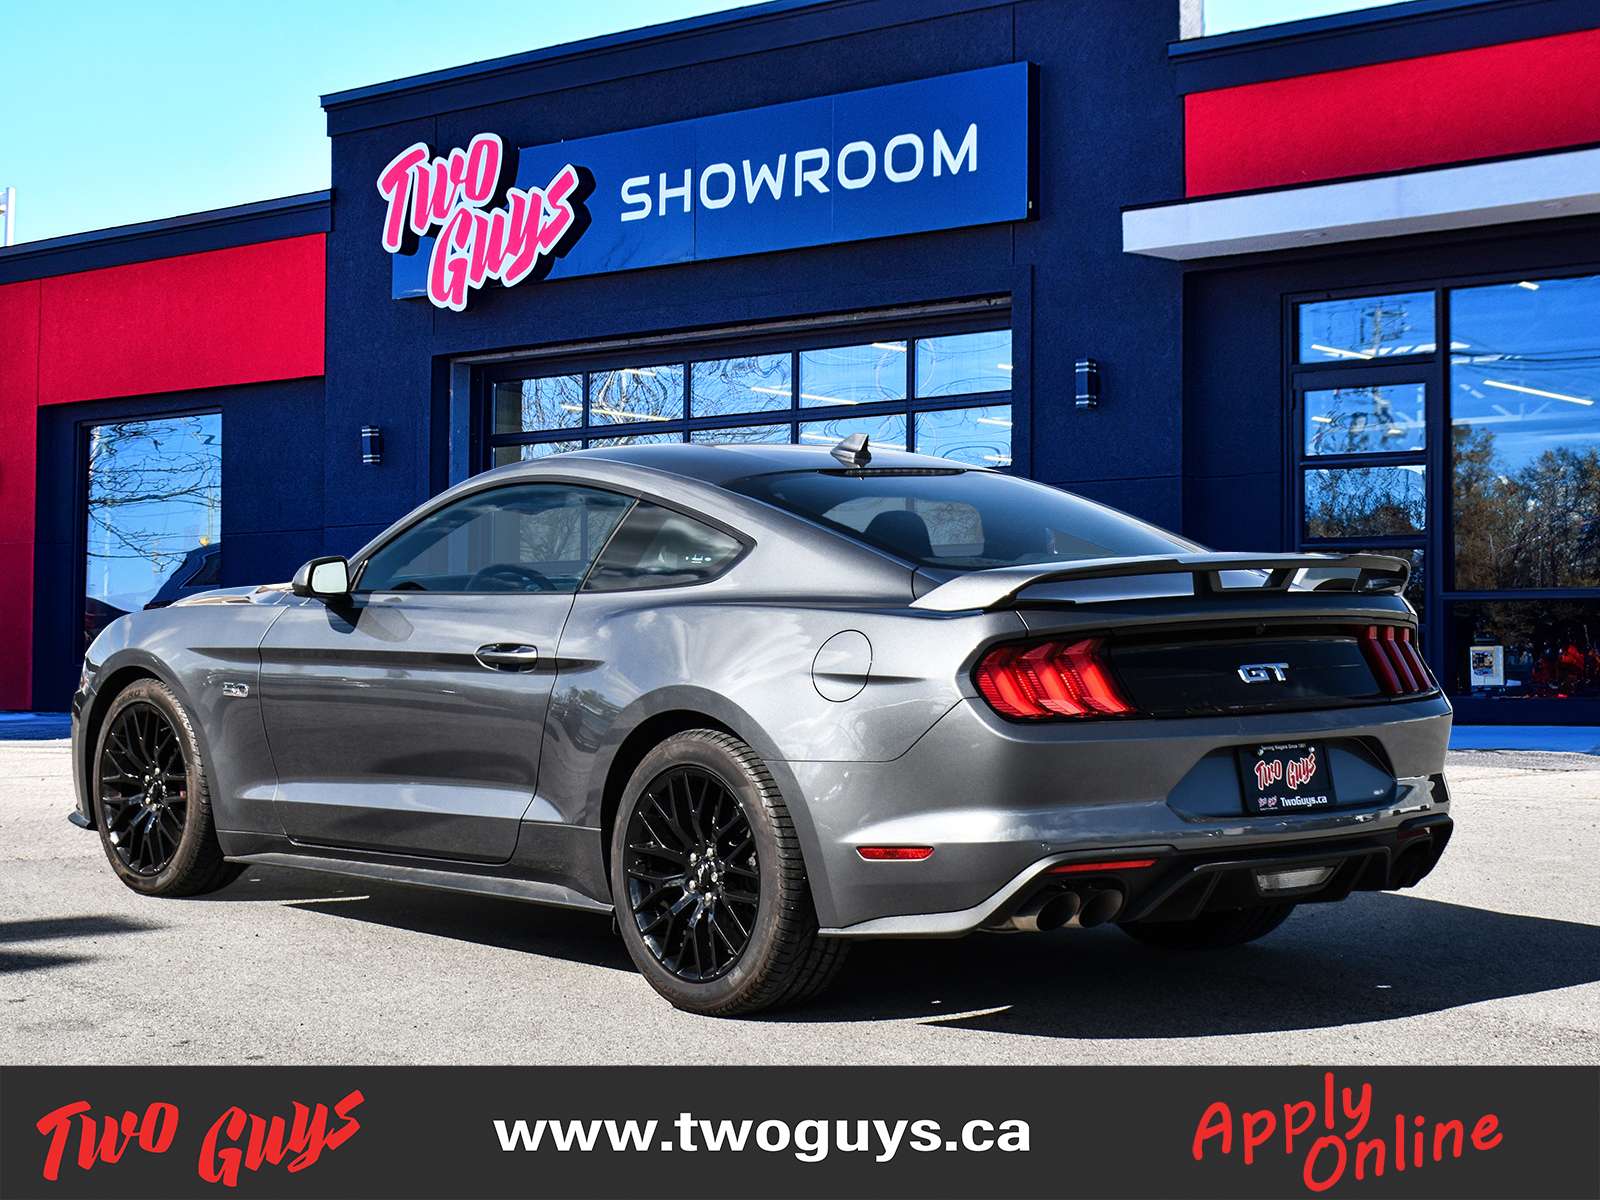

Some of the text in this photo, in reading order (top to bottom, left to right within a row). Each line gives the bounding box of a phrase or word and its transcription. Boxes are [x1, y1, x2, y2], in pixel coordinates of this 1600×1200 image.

[378, 133, 504, 253] Two
[620, 123, 978, 222] SHOWROOM
[427, 164, 578, 311] Guys
[1237, 662, 1289, 684] GT
[1280, 795, 1328, 807] TwoGuys.ca
